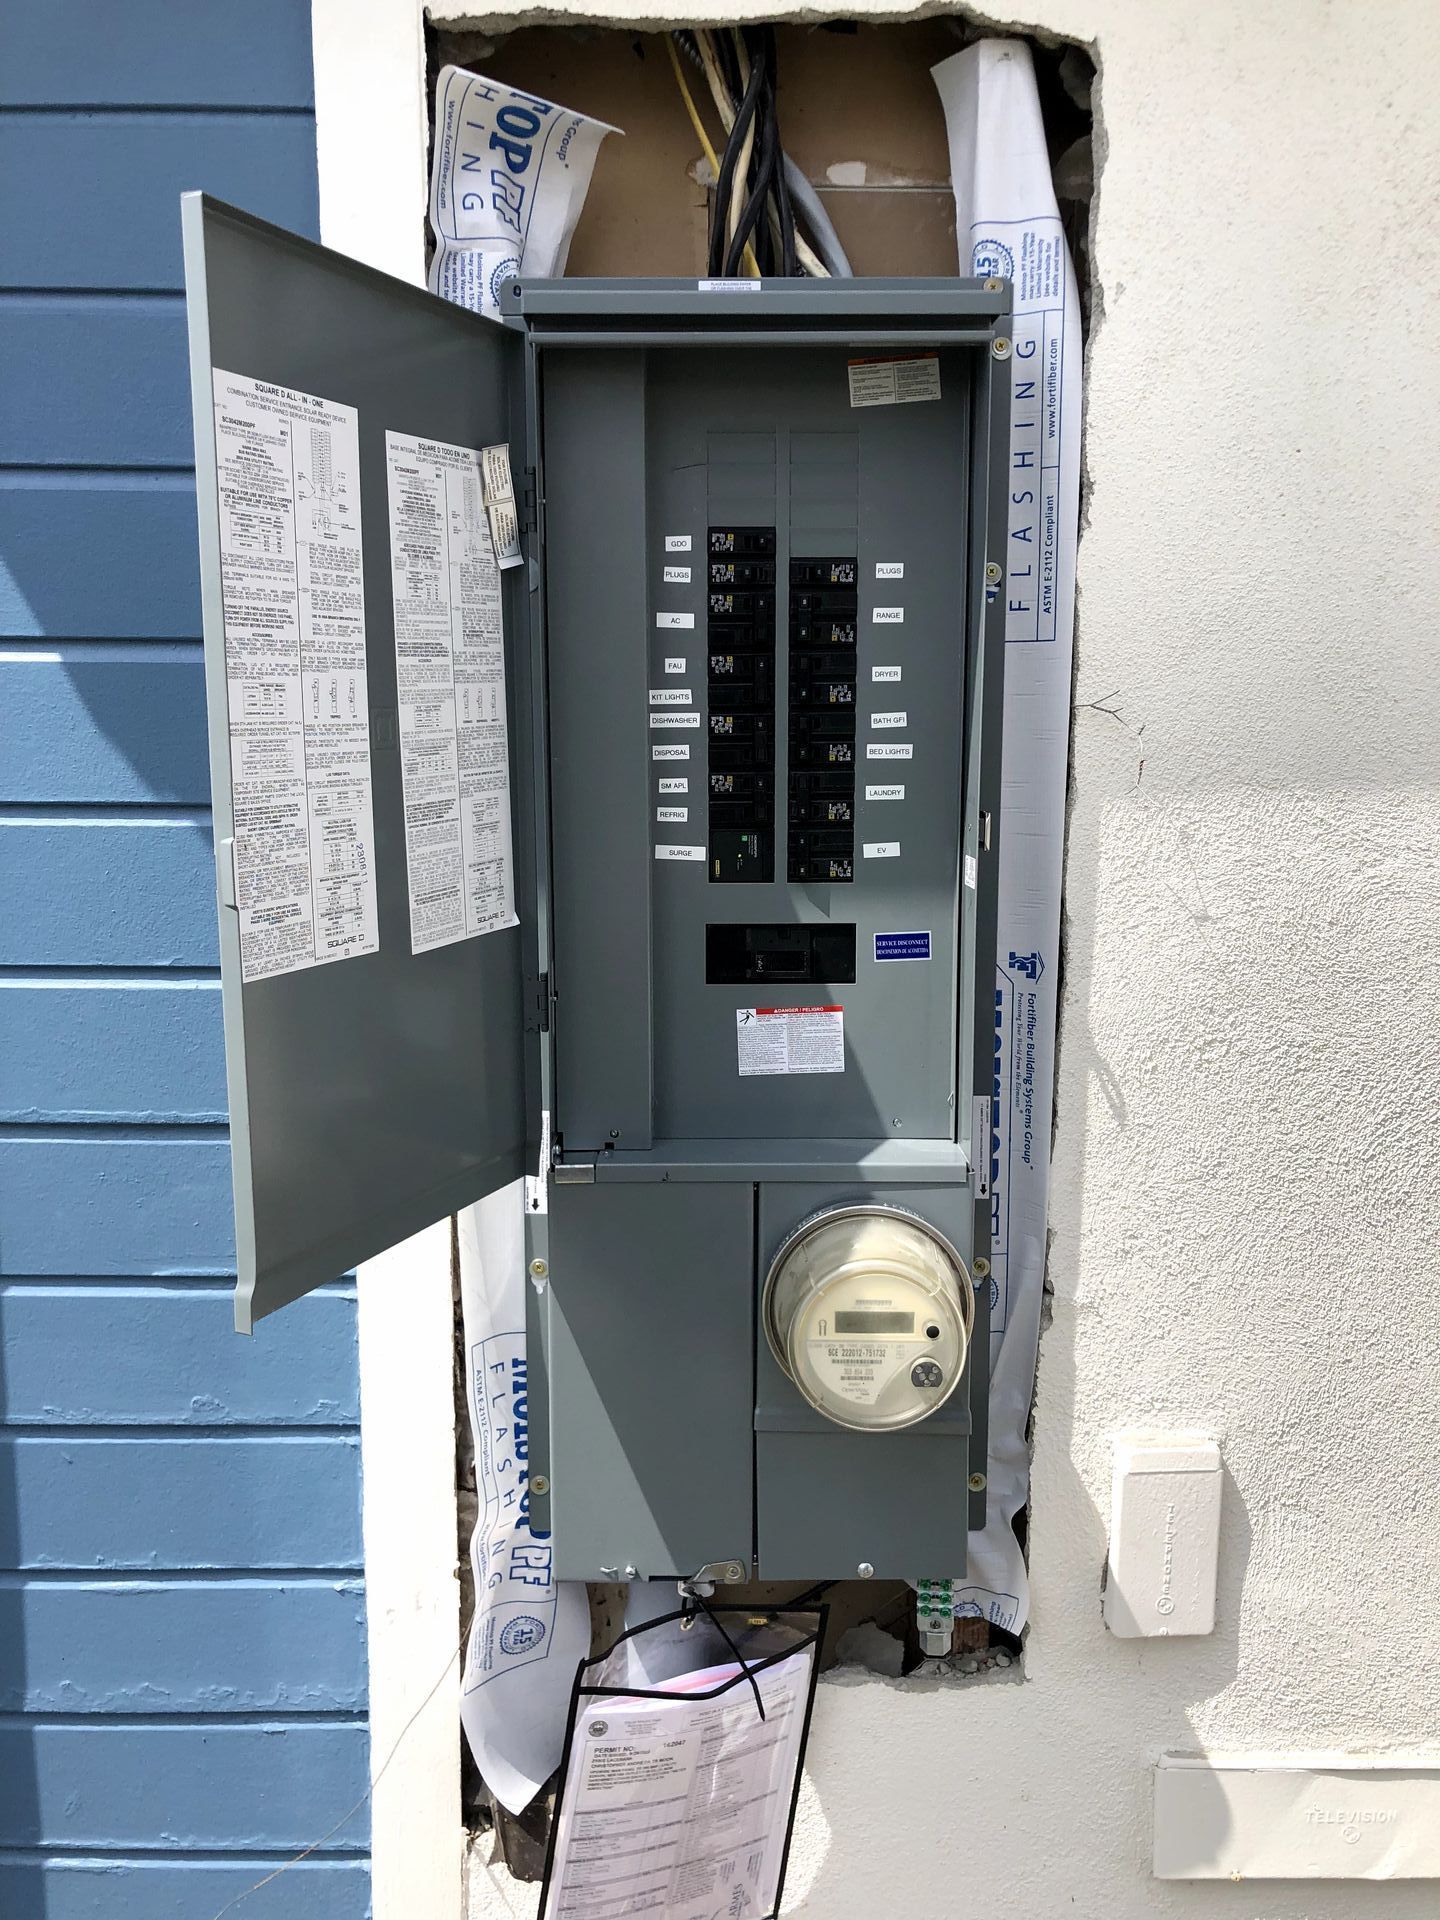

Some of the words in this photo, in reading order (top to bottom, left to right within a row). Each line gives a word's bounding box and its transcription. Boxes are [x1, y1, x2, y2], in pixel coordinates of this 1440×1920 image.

[439, 100, 456, 210] www.fortifiber.com
[556, 126, 577, 162] Group
[227, 386, 259, 400] COMBINATION
[260, 396, 279, 406] SERVICE
[254, 383, 280, 396] SQUARE
[287, 392, 297, 401] ALL
[302, 396, 307, 404] IN
[312, 399, 324, 408] ONE
[1048, 338, 1058, 438] www.fortifiber.com
[418, 443, 436, 453] SQUARE
[1044, 495, 1056, 547] Compliant
[1044, 550, 1053, 583] E-2112
[1043, 587, 1052, 614] ASTM
[327, 936, 357, 948] SQUARE
[1026, 992, 1036, 1041] Fortifiber
[1023, 1043, 1035, 1086] Building
[1023, 1088, 1034, 1129] Systems
[1022, 1131, 1033, 1164] Group
[828, 1348, 838, 1356] SCE
[478, 1398, 487, 1428] E-2112
[1162, 1504, 1176, 1596] TELEPHONE
[1304, 1809, 1398, 1824] TELEVISION
